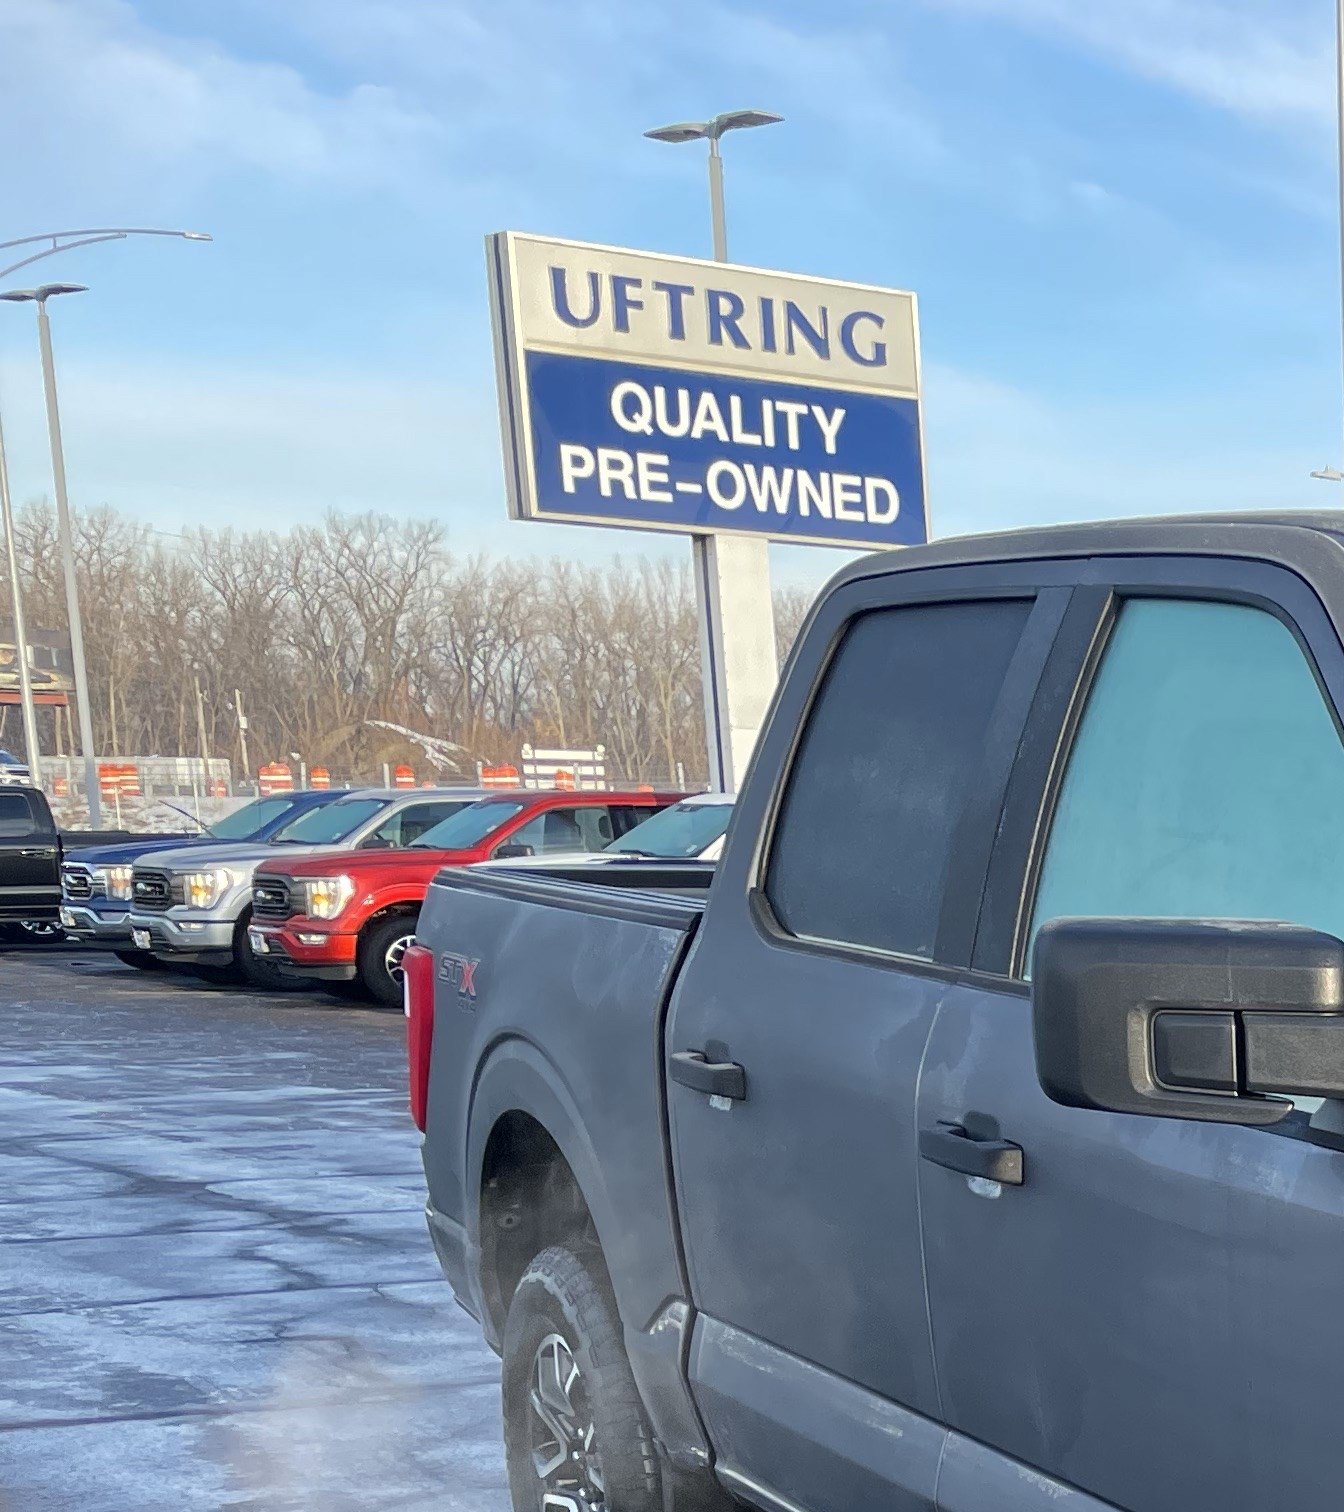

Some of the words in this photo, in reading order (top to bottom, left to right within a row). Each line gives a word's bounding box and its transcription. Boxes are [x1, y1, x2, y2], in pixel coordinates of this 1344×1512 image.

[548, 266, 888, 368] UFTRING
[610, 381, 847, 456] QUALITY
[559, 443, 901, 525] PRE-OWNED
[438, 951, 482, 1001] STX
